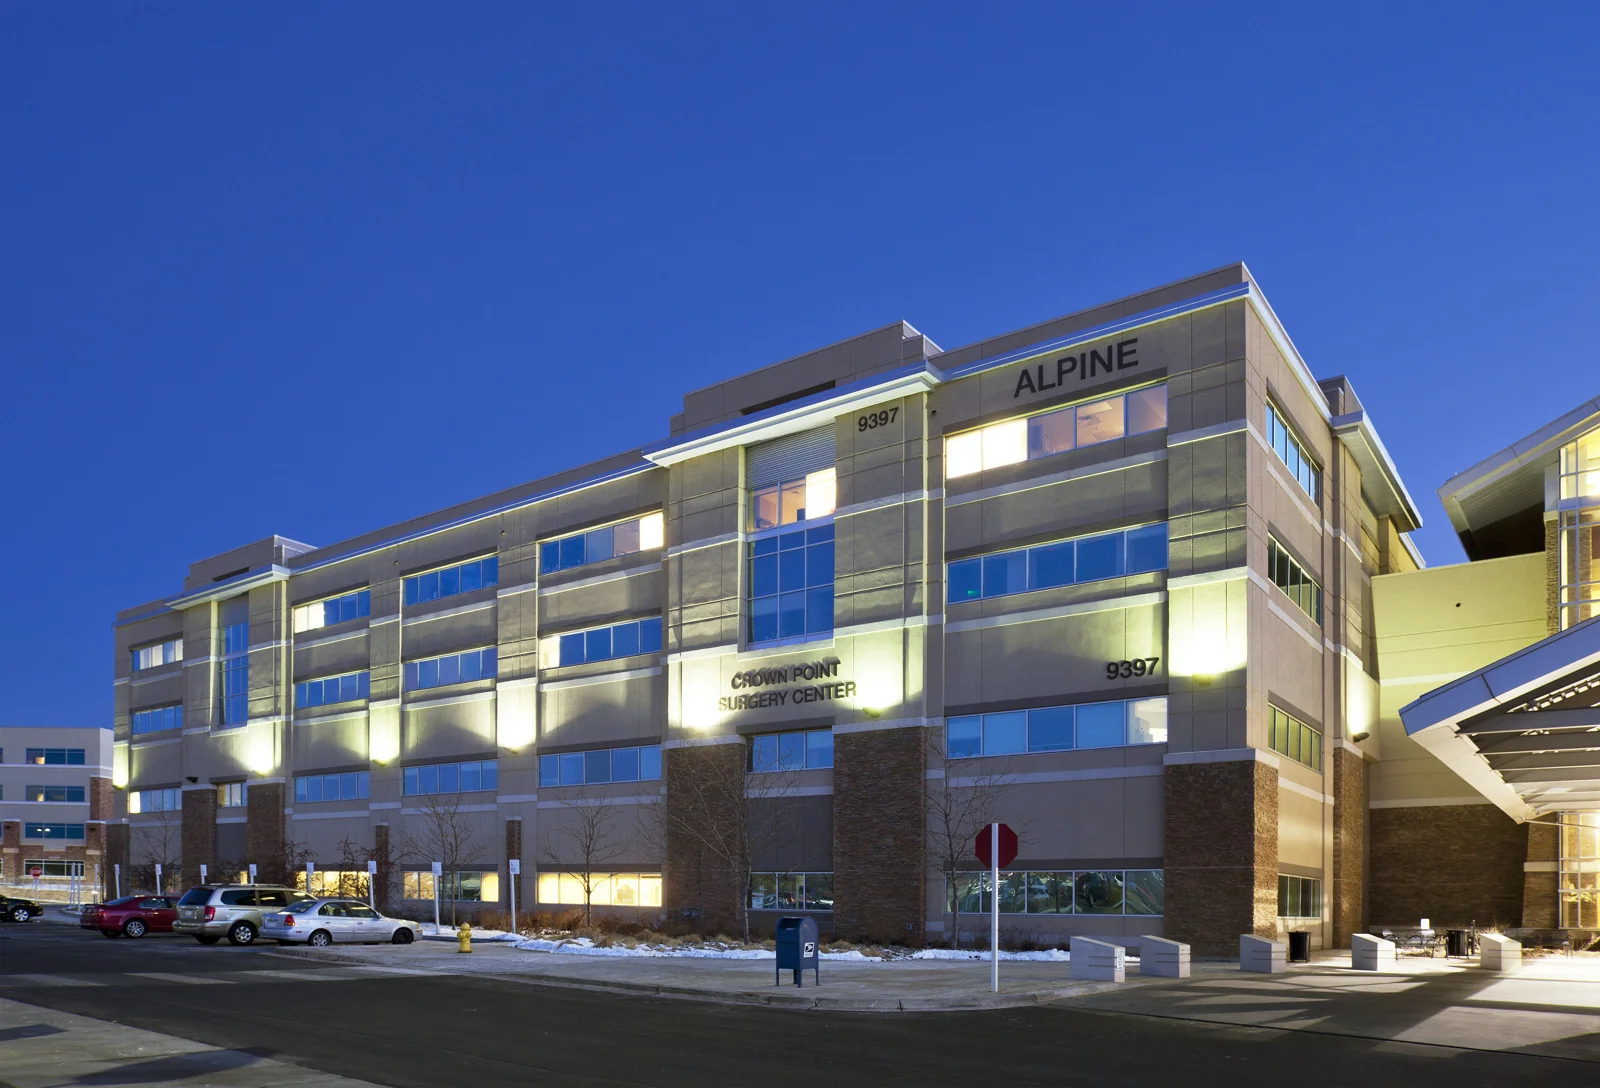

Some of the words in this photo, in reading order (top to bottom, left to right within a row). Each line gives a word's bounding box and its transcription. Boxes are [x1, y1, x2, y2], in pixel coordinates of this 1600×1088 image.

[1013, 337, 1139, 398] ALPINE
[858, 406, 899, 432] 9397
[731, 668, 788, 689] CROWN
[793, 659, 841, 682] POINT
[1106, 656, 1160, 680] 9397
[718, 690, 788, 711] SURGERY
[792, 681, 857, 704] CENTER
